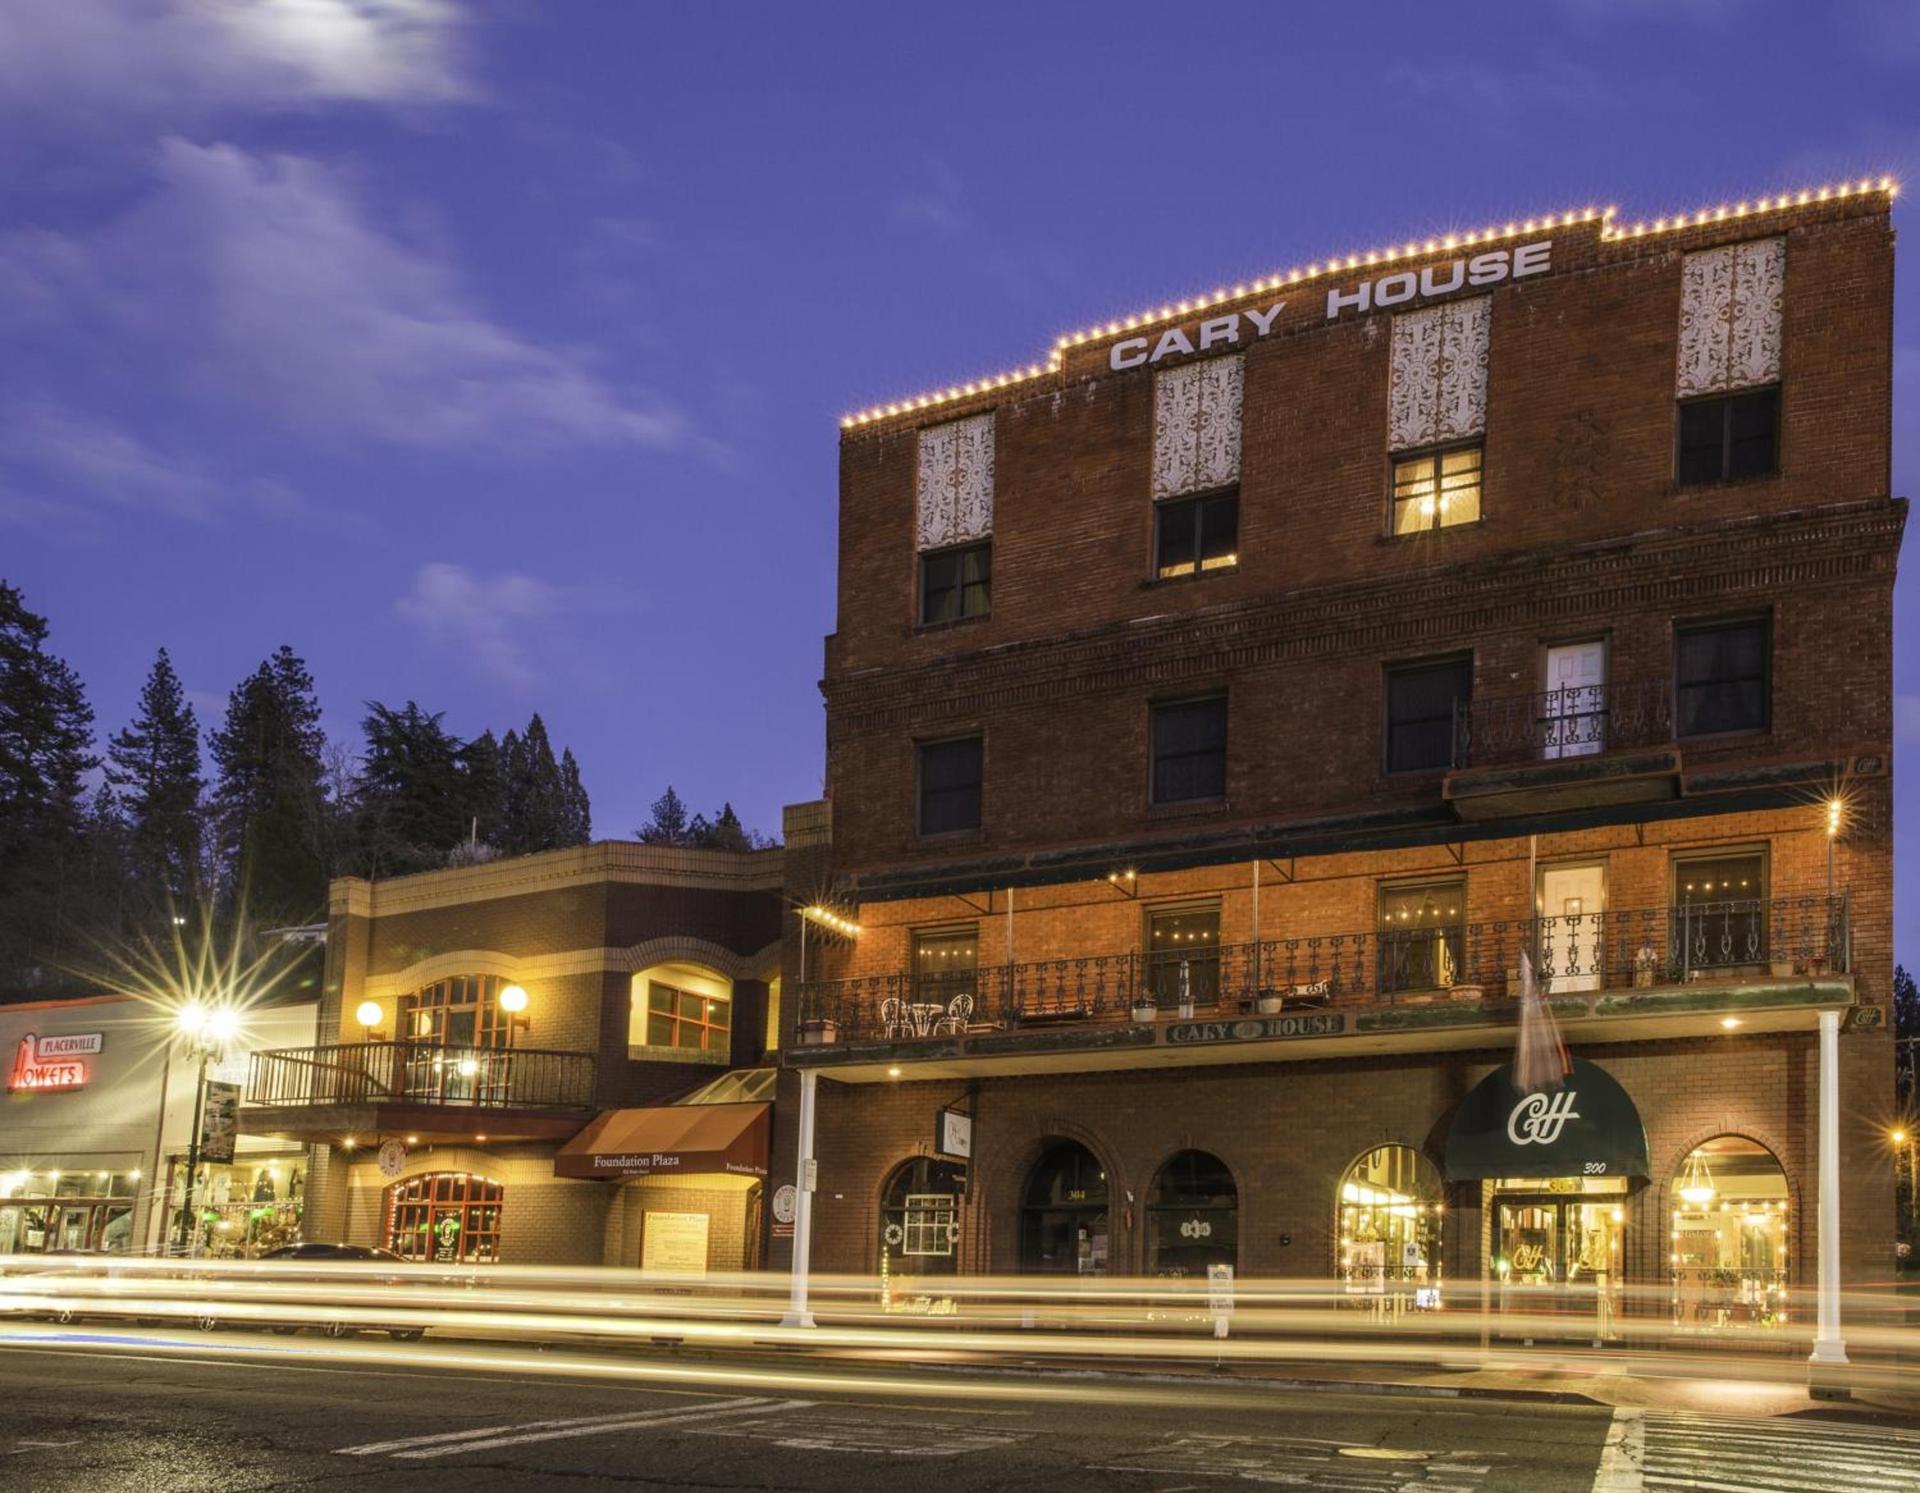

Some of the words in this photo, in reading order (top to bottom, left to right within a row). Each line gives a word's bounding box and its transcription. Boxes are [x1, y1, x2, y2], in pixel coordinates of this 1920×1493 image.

[1110, 302, 1287, 370] CARY
[1326, 241, 1552, 319] HOUSE
[1172, 1023, 1228, 1042] CARY
[1267, 1015, 1338, 1035] HOUSE
[44, 1037, 96, 1053] PLACERVILLE
[594, 1155, 650, 1168] Foundation
[652, 1154, 680, 1167] Plaza
[1583, 1162, 1607, 1174] 300
